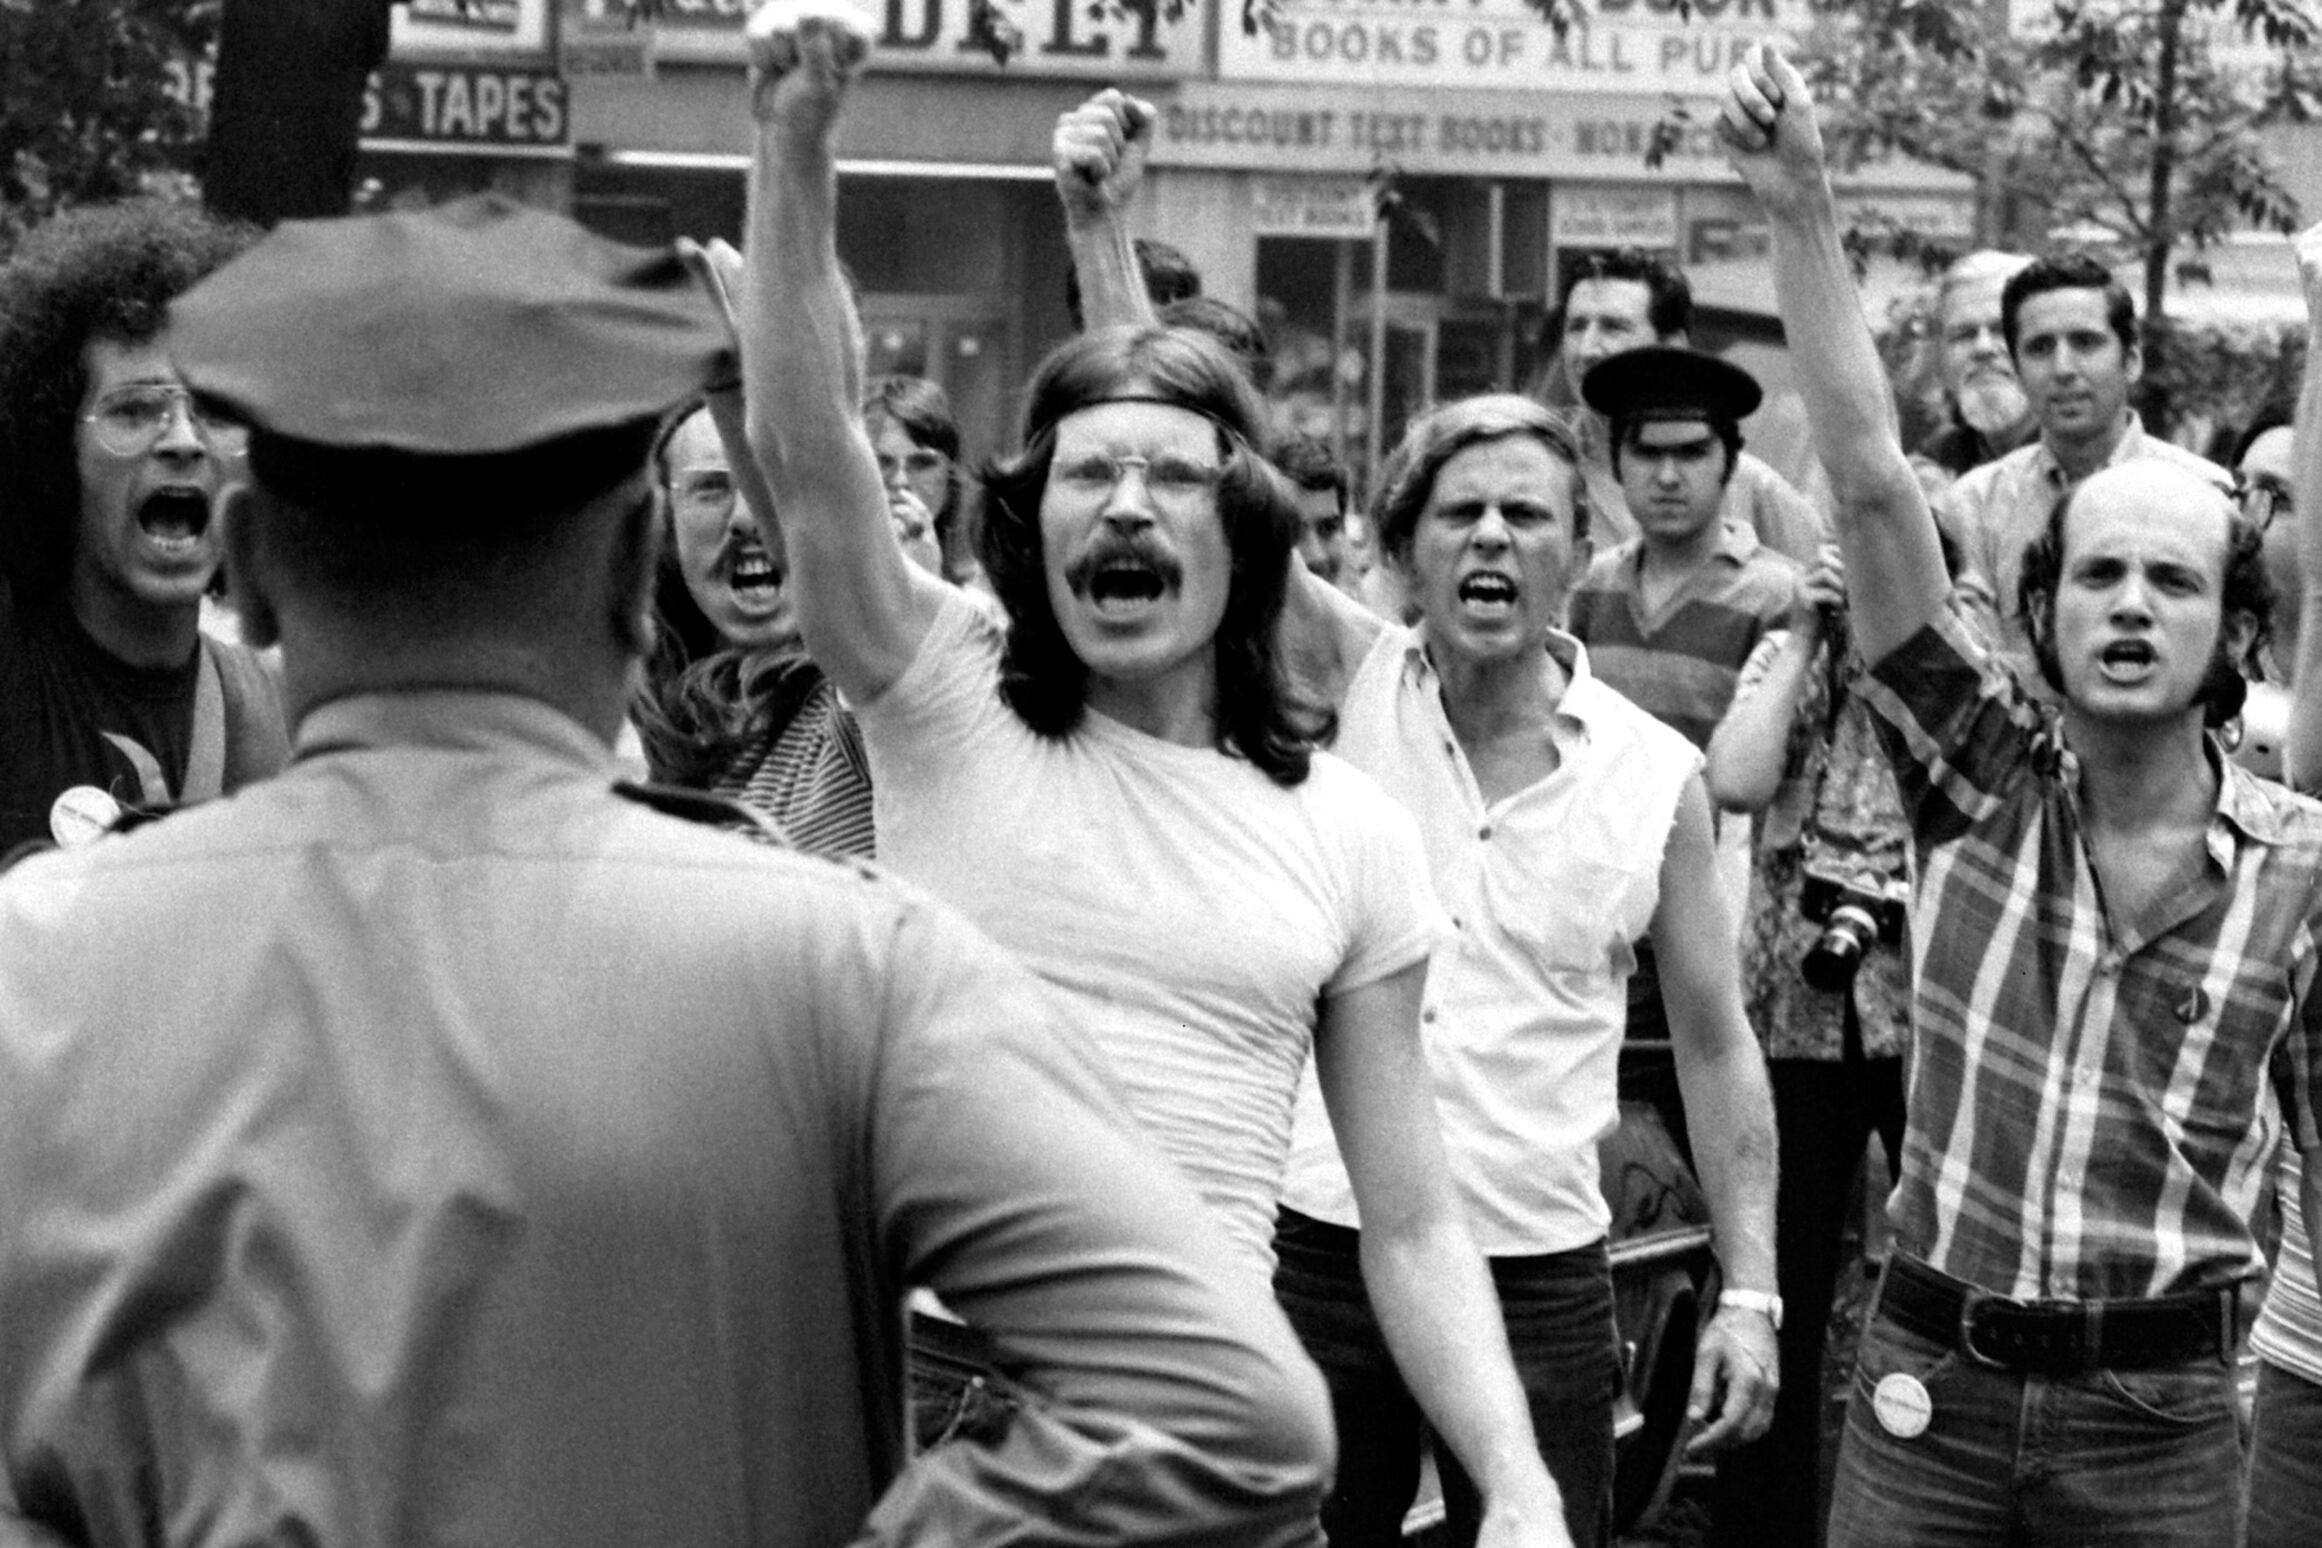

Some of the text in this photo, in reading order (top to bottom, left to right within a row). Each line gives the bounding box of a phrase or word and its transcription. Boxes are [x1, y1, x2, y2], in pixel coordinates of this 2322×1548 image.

[1266, 22, 1437, 66] BOOKS
[1463, 28, 1524, 67] OF
[414, 71, 563, 138] TAPES
[1166, 102, 1334, 148] DISCOUNT
